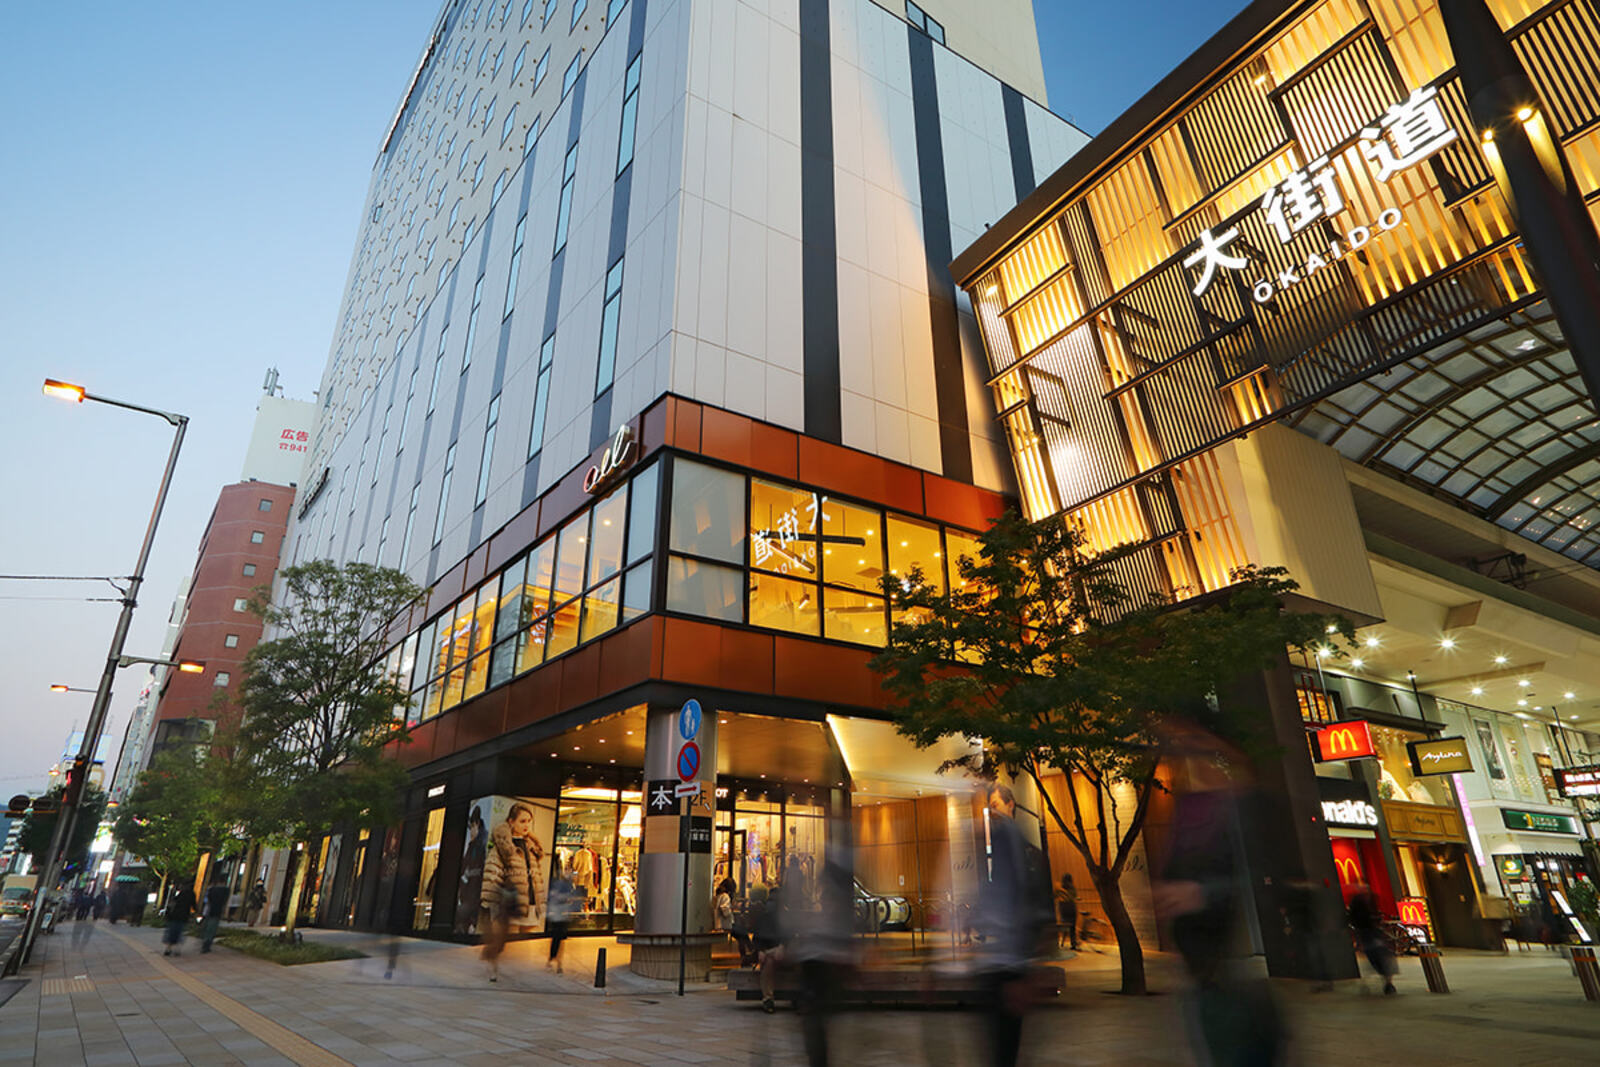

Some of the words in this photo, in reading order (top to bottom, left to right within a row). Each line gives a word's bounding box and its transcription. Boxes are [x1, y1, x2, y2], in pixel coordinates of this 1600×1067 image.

[1183, 86, 1460, 297] 大街道
[281, 429, 309, 442] 広告
[651, 785, 673, 811] 本
